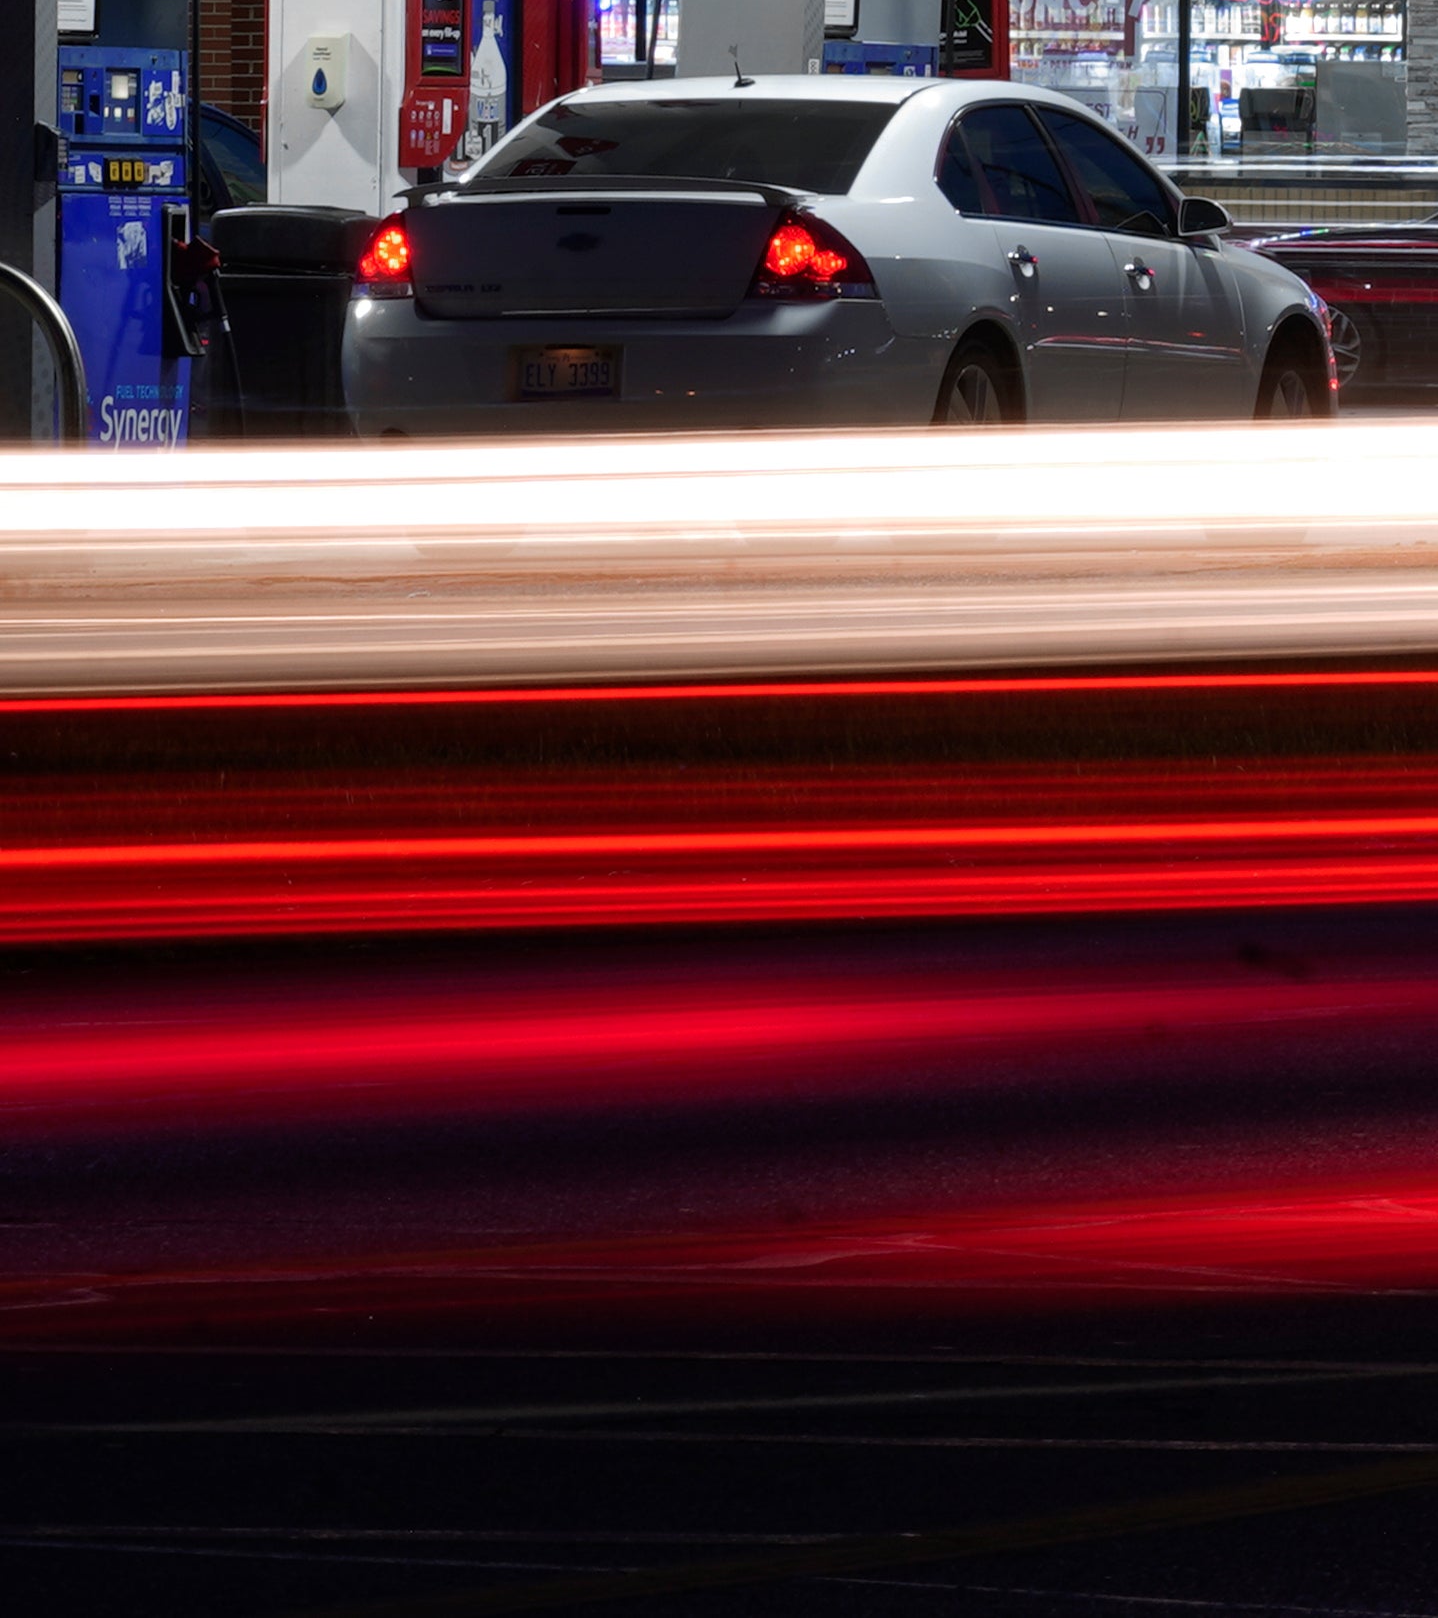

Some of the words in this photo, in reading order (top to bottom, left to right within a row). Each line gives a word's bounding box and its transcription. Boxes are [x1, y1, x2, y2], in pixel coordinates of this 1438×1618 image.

[526, 363, 556, 387] ELY
[569, 363, 609, 387] 3399
[116, 385, 134, 399] FUEL
[100, 395, 183, 454] Synergy
